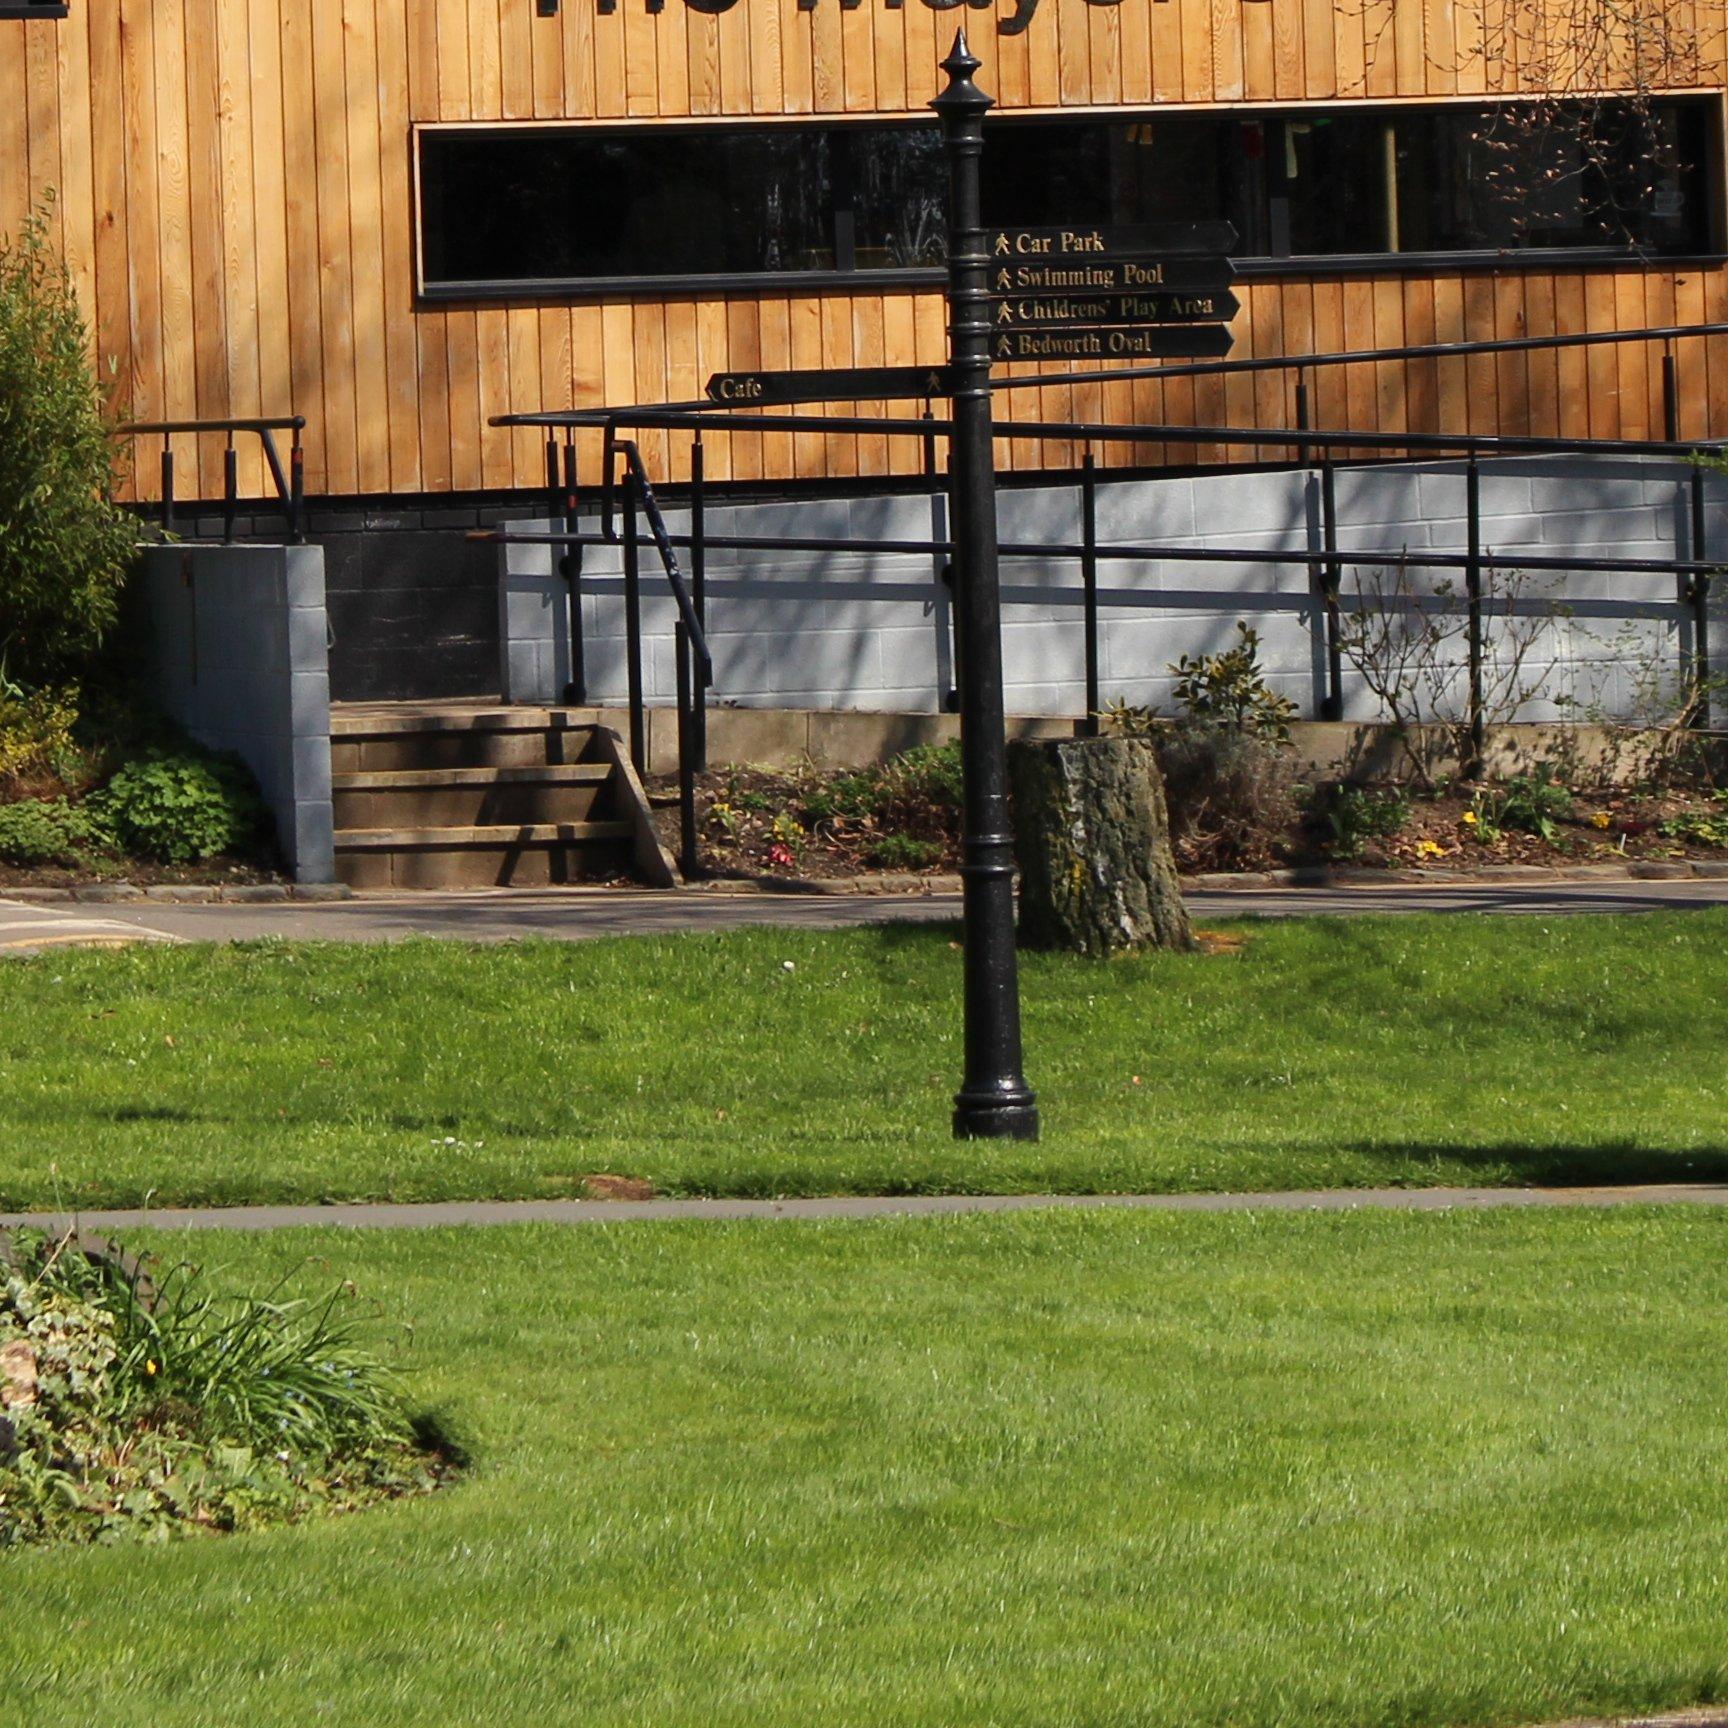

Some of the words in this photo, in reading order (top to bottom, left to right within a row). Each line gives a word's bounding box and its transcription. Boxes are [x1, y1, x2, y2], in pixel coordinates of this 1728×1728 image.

[1016, 233, 1052, 254] Car
[1061, 232, 1104, 253] Park
[1017, 266, 1115, 288] Swimming
[1124, 263, 1163, 284] Pool
[1018, 299, 1112, 320] Childrens'
[1120, 298, 1159, 317] Play
[1171, 296, 1214, 315] Area
[1018, 332, 1102, 355] Bedworth
[1109, 331, 1152, 353] Oval
[720, 377, 762, 399] Cafe
